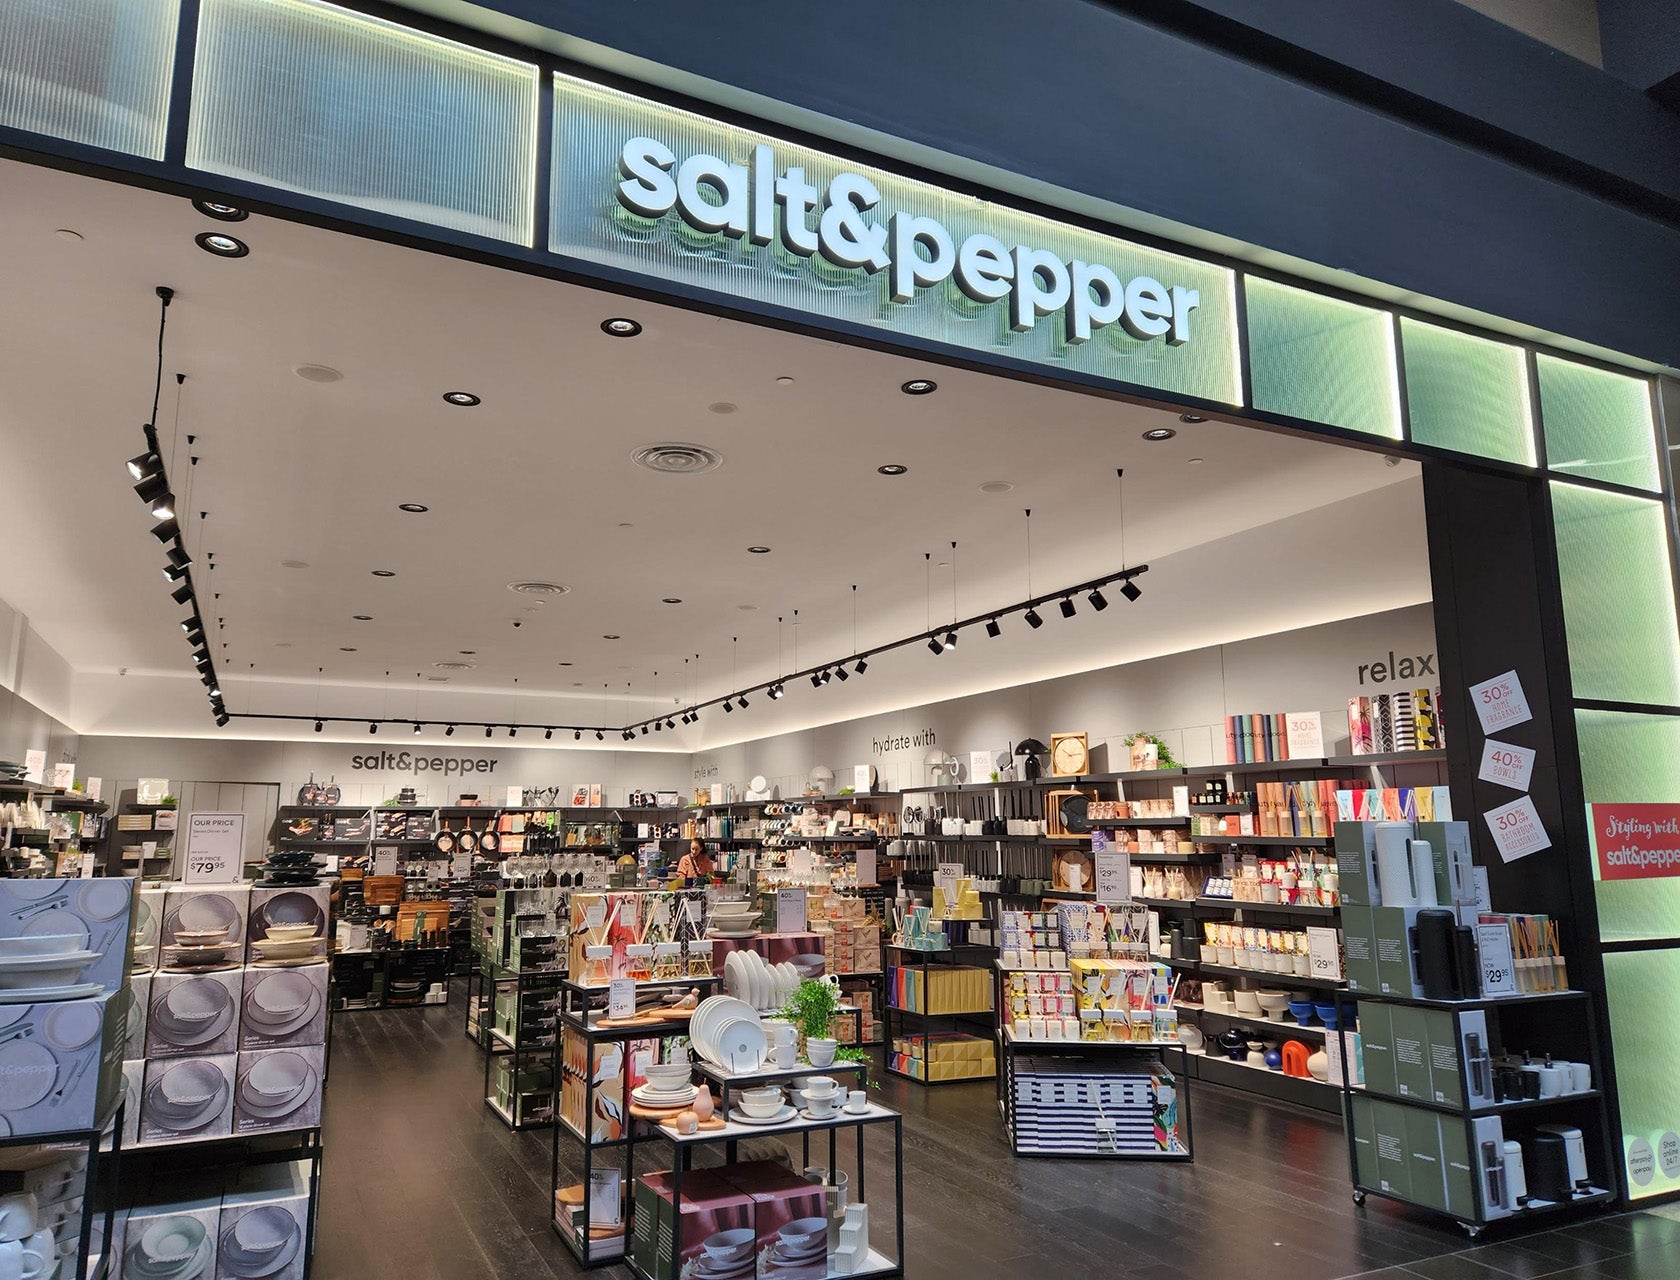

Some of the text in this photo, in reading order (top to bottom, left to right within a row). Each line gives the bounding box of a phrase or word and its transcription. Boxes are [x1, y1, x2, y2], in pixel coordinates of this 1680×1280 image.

[617, 136, 1199, 345] salt&pepper
[1358, 651, 1435, 685] relax
[1481, 683, 1509, 704] 30%
[873, 728, 936, 756] hydrate with
[351, 751, 498, 777] salt&pepper
[1492, 750, 1522, 767] 40%
[1496, 809, 1526, 831] 30%
[1606, 815, 1680, 840] Styling with
